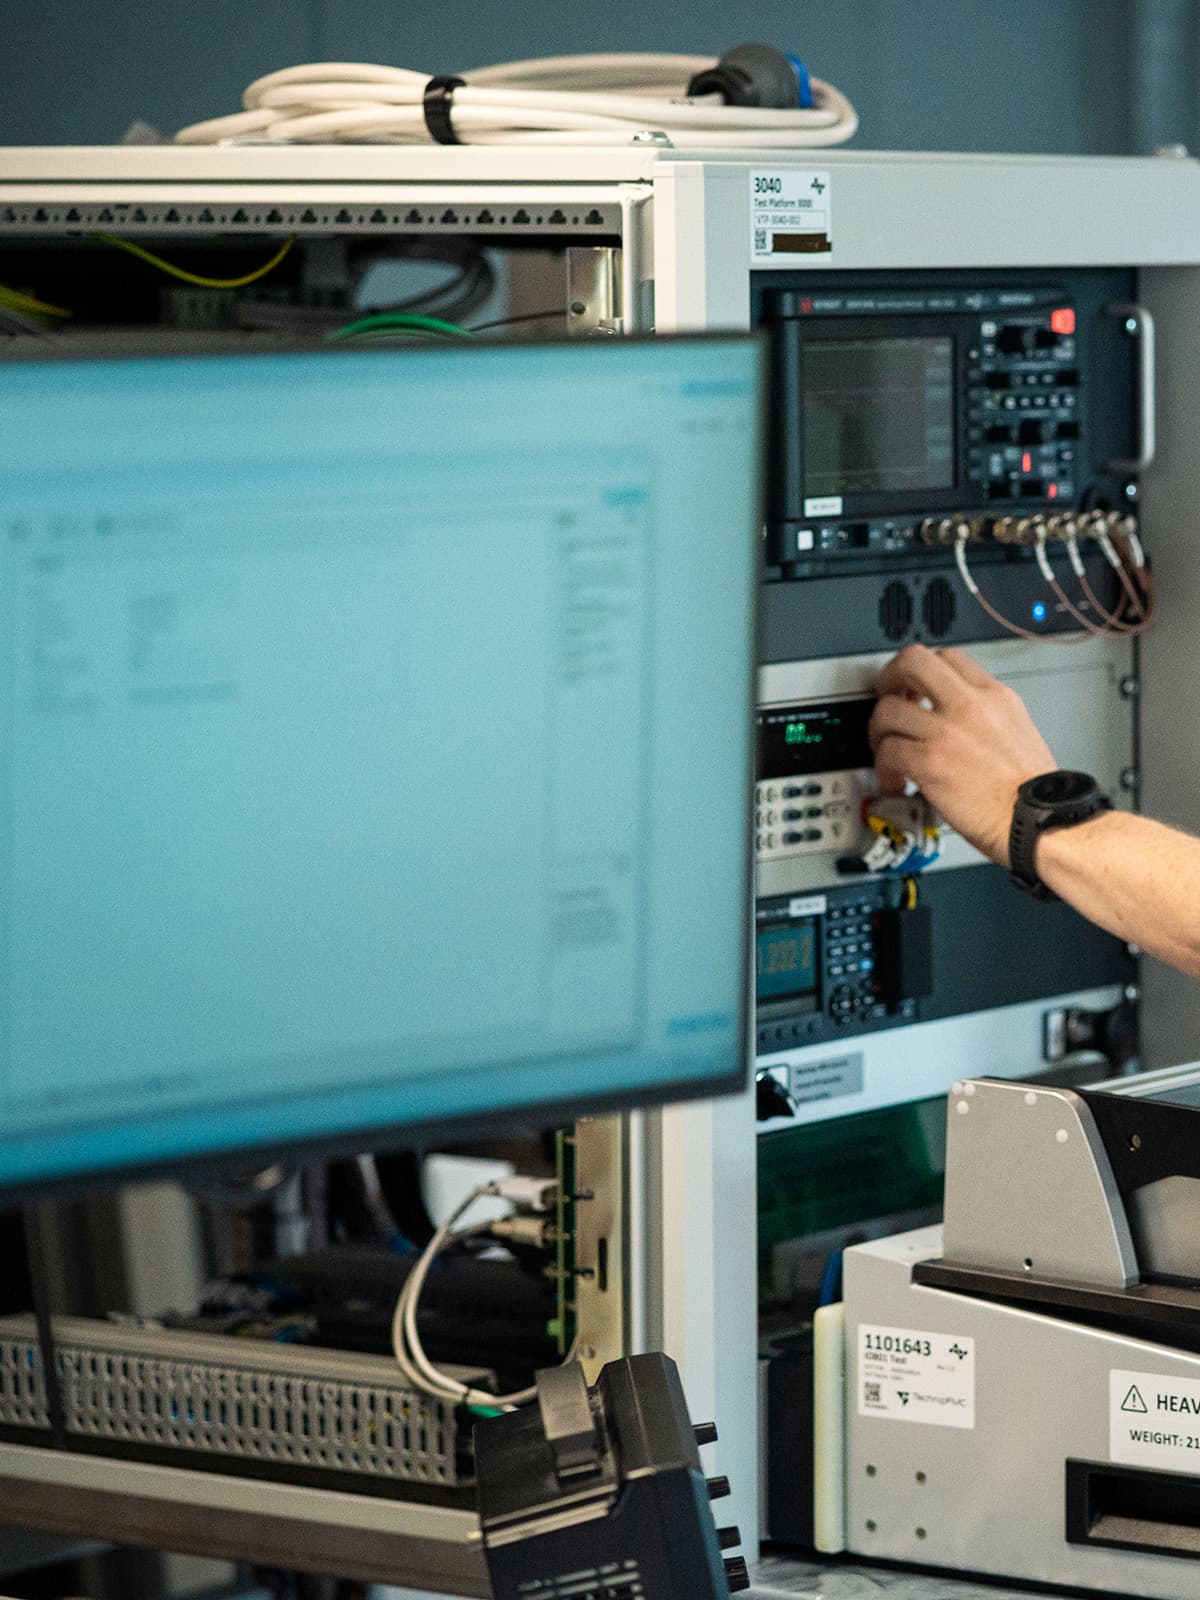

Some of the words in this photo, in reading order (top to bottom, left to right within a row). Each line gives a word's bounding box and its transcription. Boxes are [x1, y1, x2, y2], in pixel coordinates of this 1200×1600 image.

[754, 177, 782, 193] 3040
[754, 198, 767, 207] Test
[769, 198, 796, 208] Platform
[864, 1333, 932, 1357] 1101643
[1129, 1429, 1183, 1447] WEIGHT:
